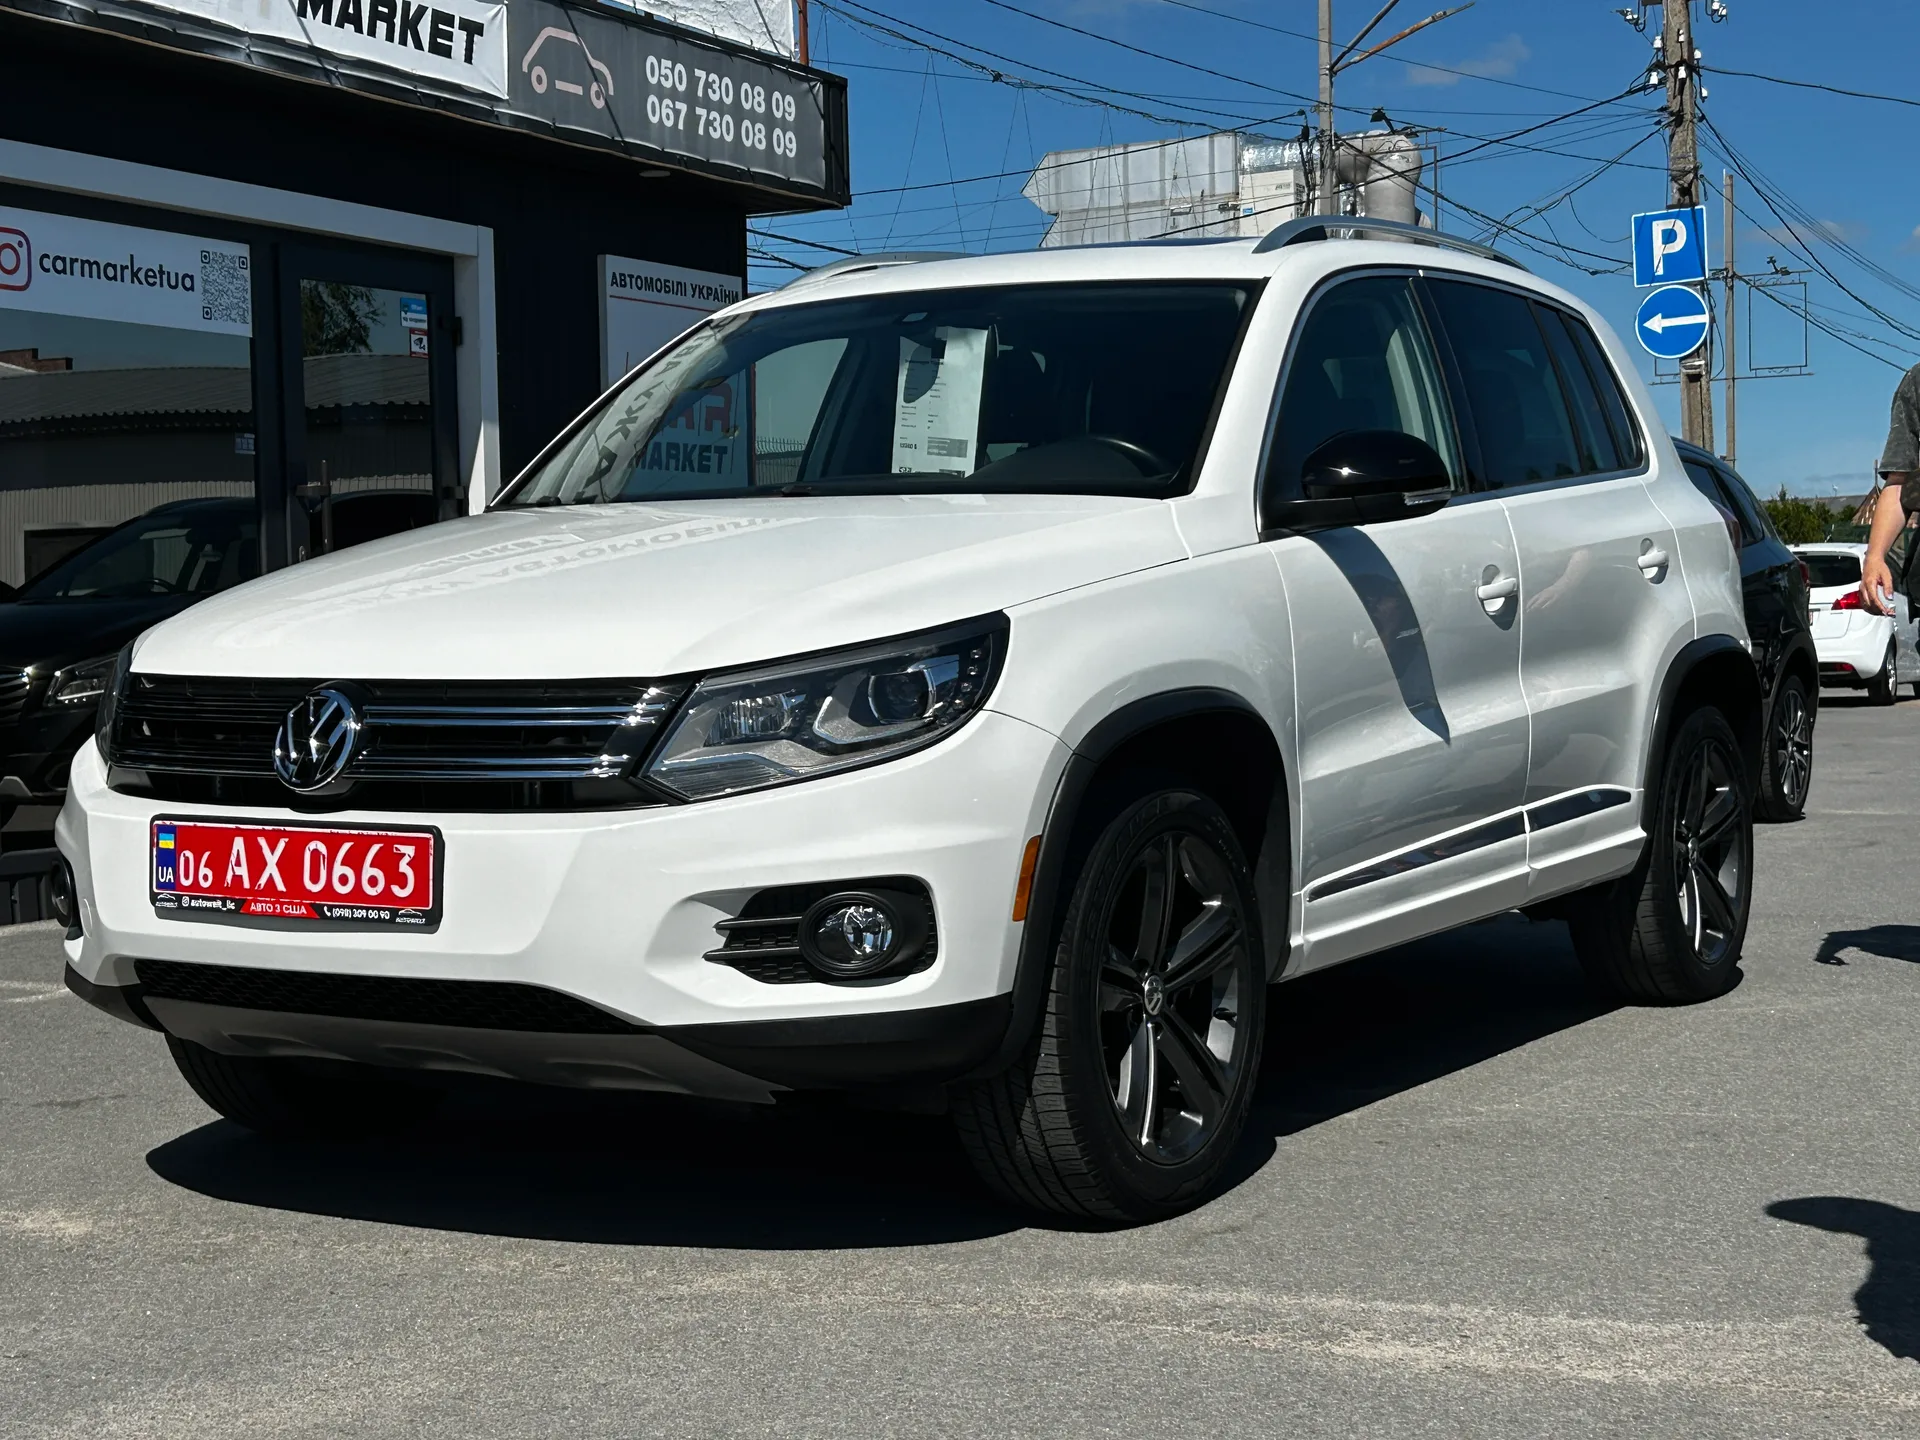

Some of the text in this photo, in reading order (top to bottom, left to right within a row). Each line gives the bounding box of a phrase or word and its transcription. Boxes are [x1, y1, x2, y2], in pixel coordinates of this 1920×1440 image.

[297, 0, 484, 65] MARKET
[645, 55, 796, 122] 050 730 08 09
[646, 94, 797, 158] 067 730 08 09
[39, 252, 195, 292] carmarketua
[1652, 219, 1686, 275] P
[610, 271, 739, 304] АВТОМОБІЛІ УКРАЇНИ
[158, 866, 174, 883] UA
[179, 836, 416, 898] 06 AX 0663
[250, 902, 273, 912] АВТО
[282, 904, 307, 914] США
